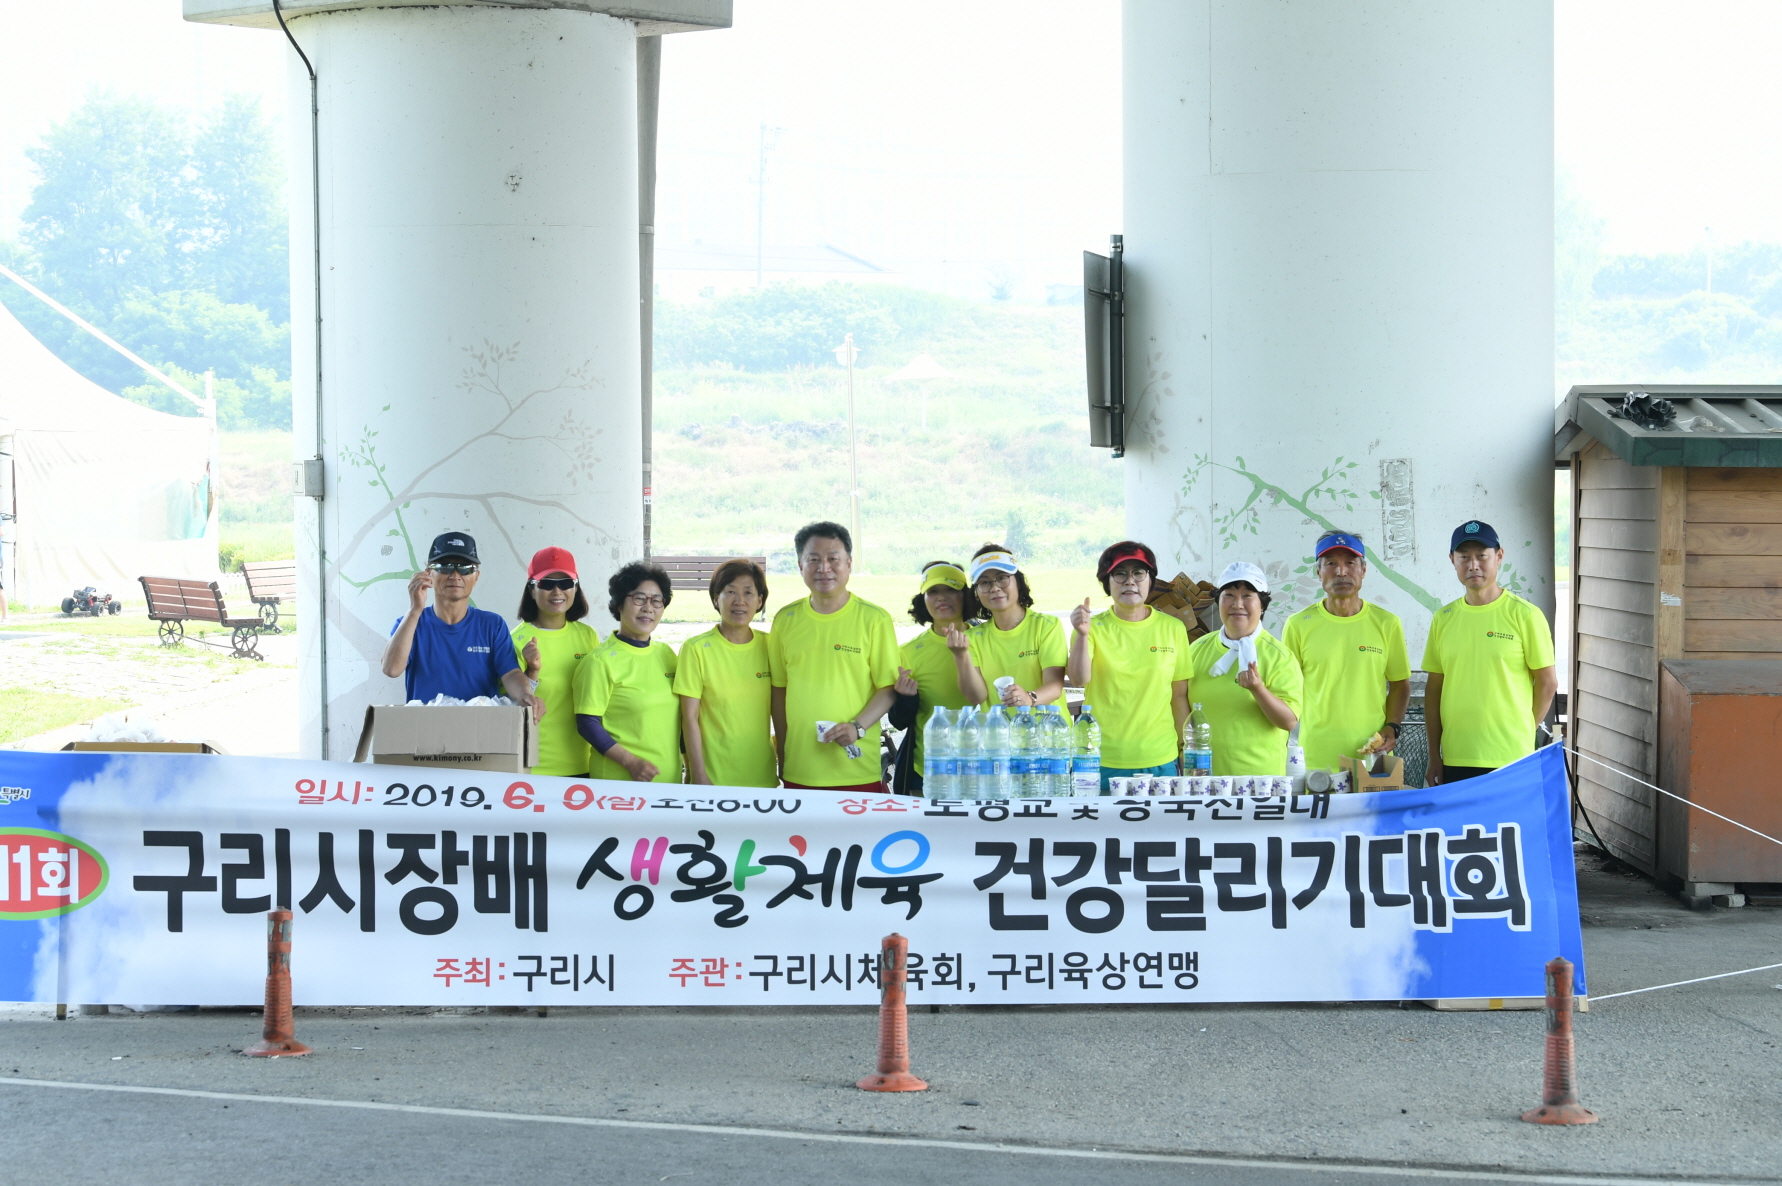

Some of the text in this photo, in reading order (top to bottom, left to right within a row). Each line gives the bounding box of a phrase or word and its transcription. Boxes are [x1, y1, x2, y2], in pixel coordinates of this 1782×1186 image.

[412, 754, 483, 764] www.kimony.co.kr
[295, 779, 374, 805] 일시:
[383, 783, 492, 810] 2019.
[502, 781, 546, 813] 6.
[133, 824, 1527, 936] 구리시장배 생활체육 건강달리기대회
[987, 951, 1199, 991] 구리육상연맹
